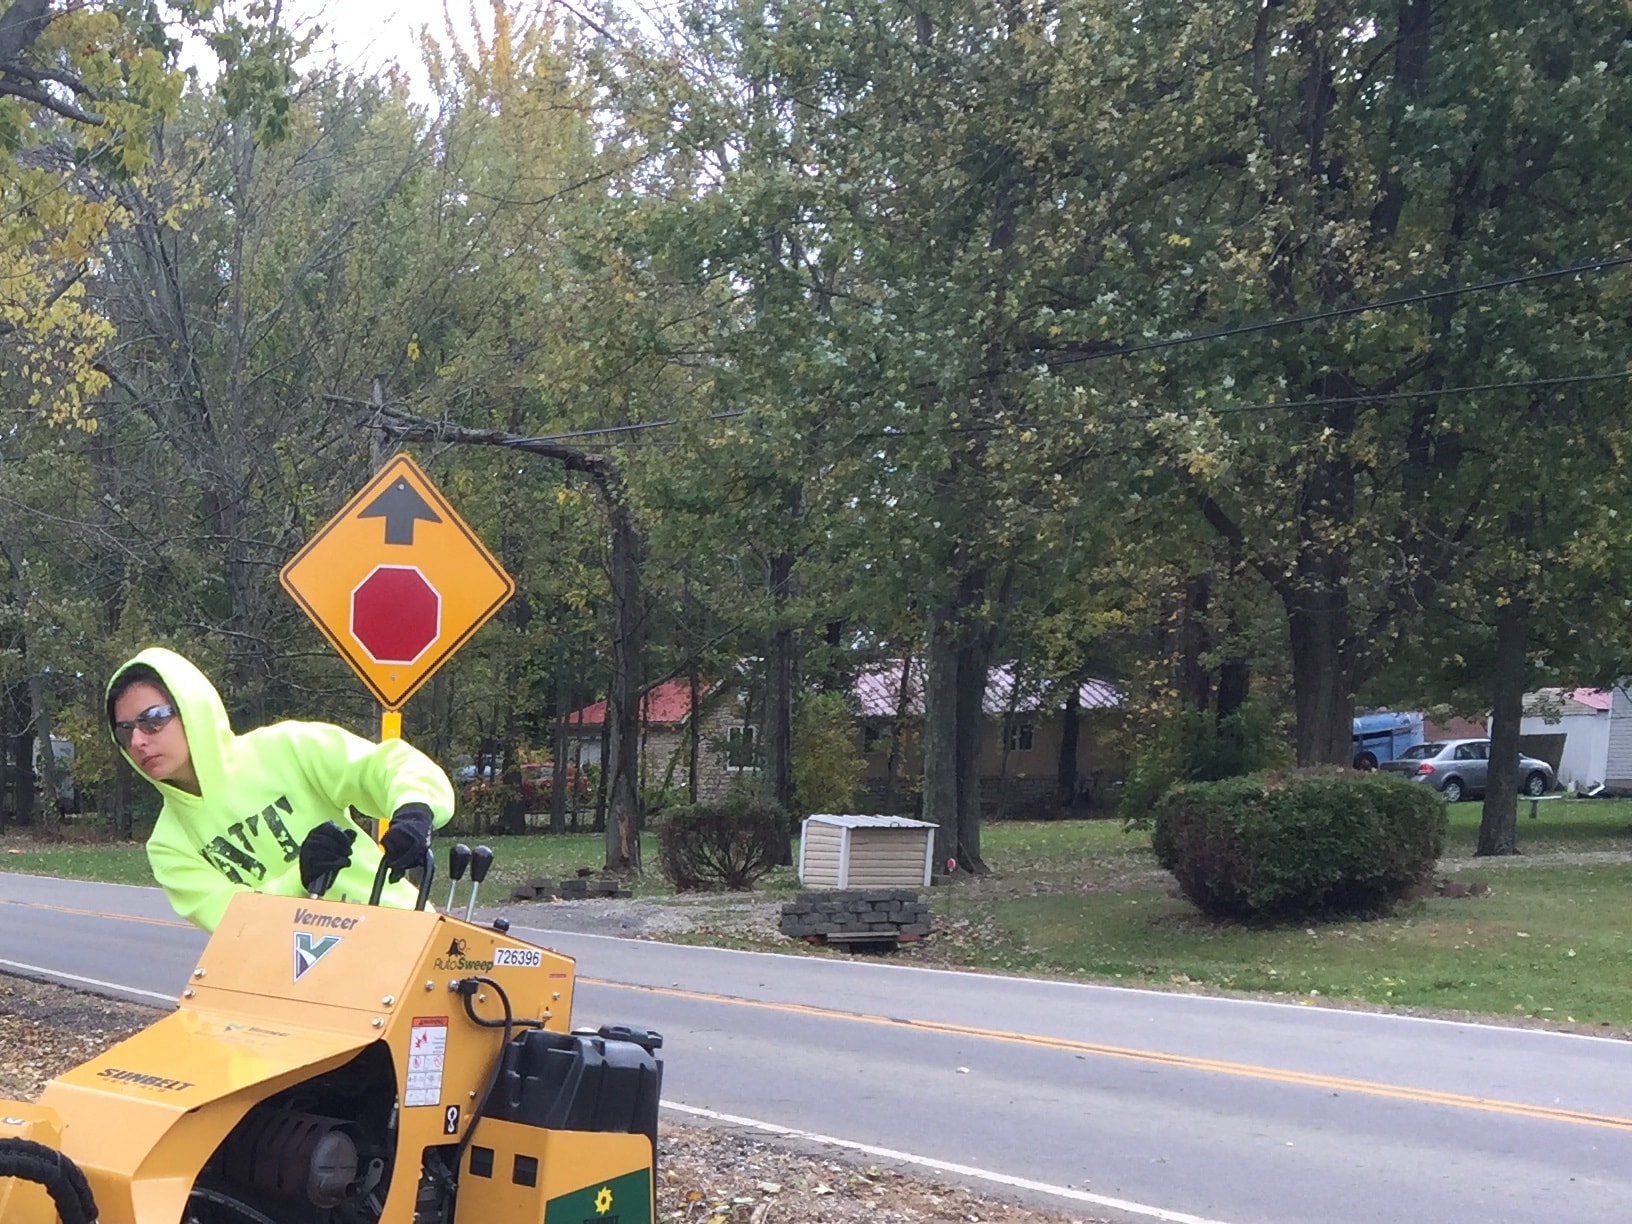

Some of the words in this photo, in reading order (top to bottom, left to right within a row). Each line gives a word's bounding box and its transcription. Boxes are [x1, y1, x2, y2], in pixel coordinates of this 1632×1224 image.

[293, 907, 359, 931] Vermeer
[432, 956, 494, 974] AutoSweep
[496, 949, 540, 966] 726396
[96, 1067, 196, 1092] SUNBELT
